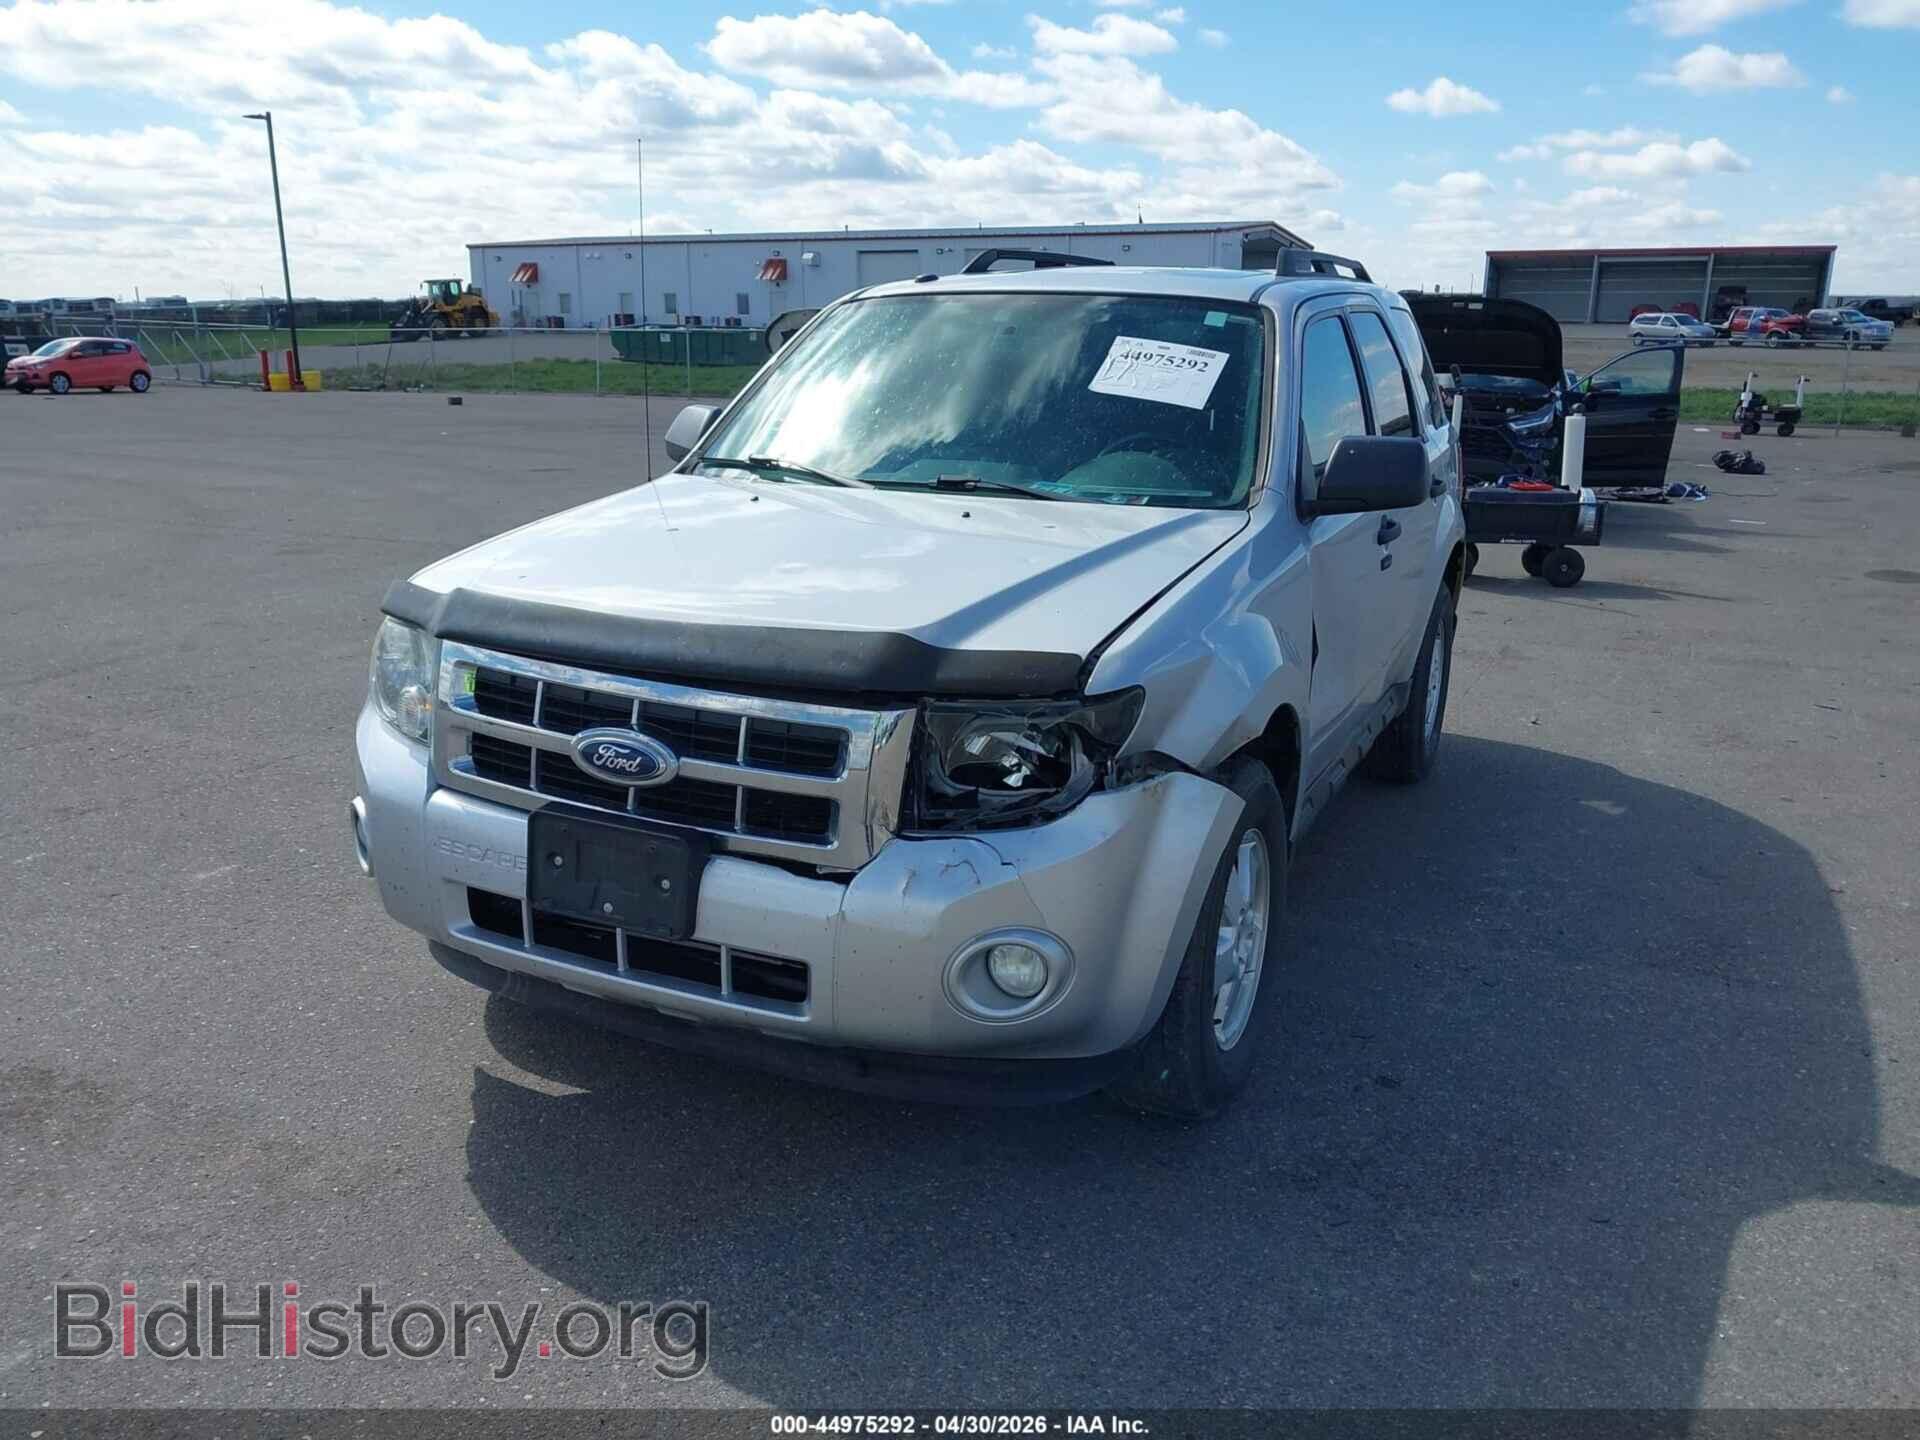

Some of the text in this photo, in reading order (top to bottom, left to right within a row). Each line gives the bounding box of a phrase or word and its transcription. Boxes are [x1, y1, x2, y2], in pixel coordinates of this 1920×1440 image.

[1119, 347, 1209, 373] 44975292
[593, 743, 642, 773] Ford
[437, 836, 528, 872] ESCAPE
